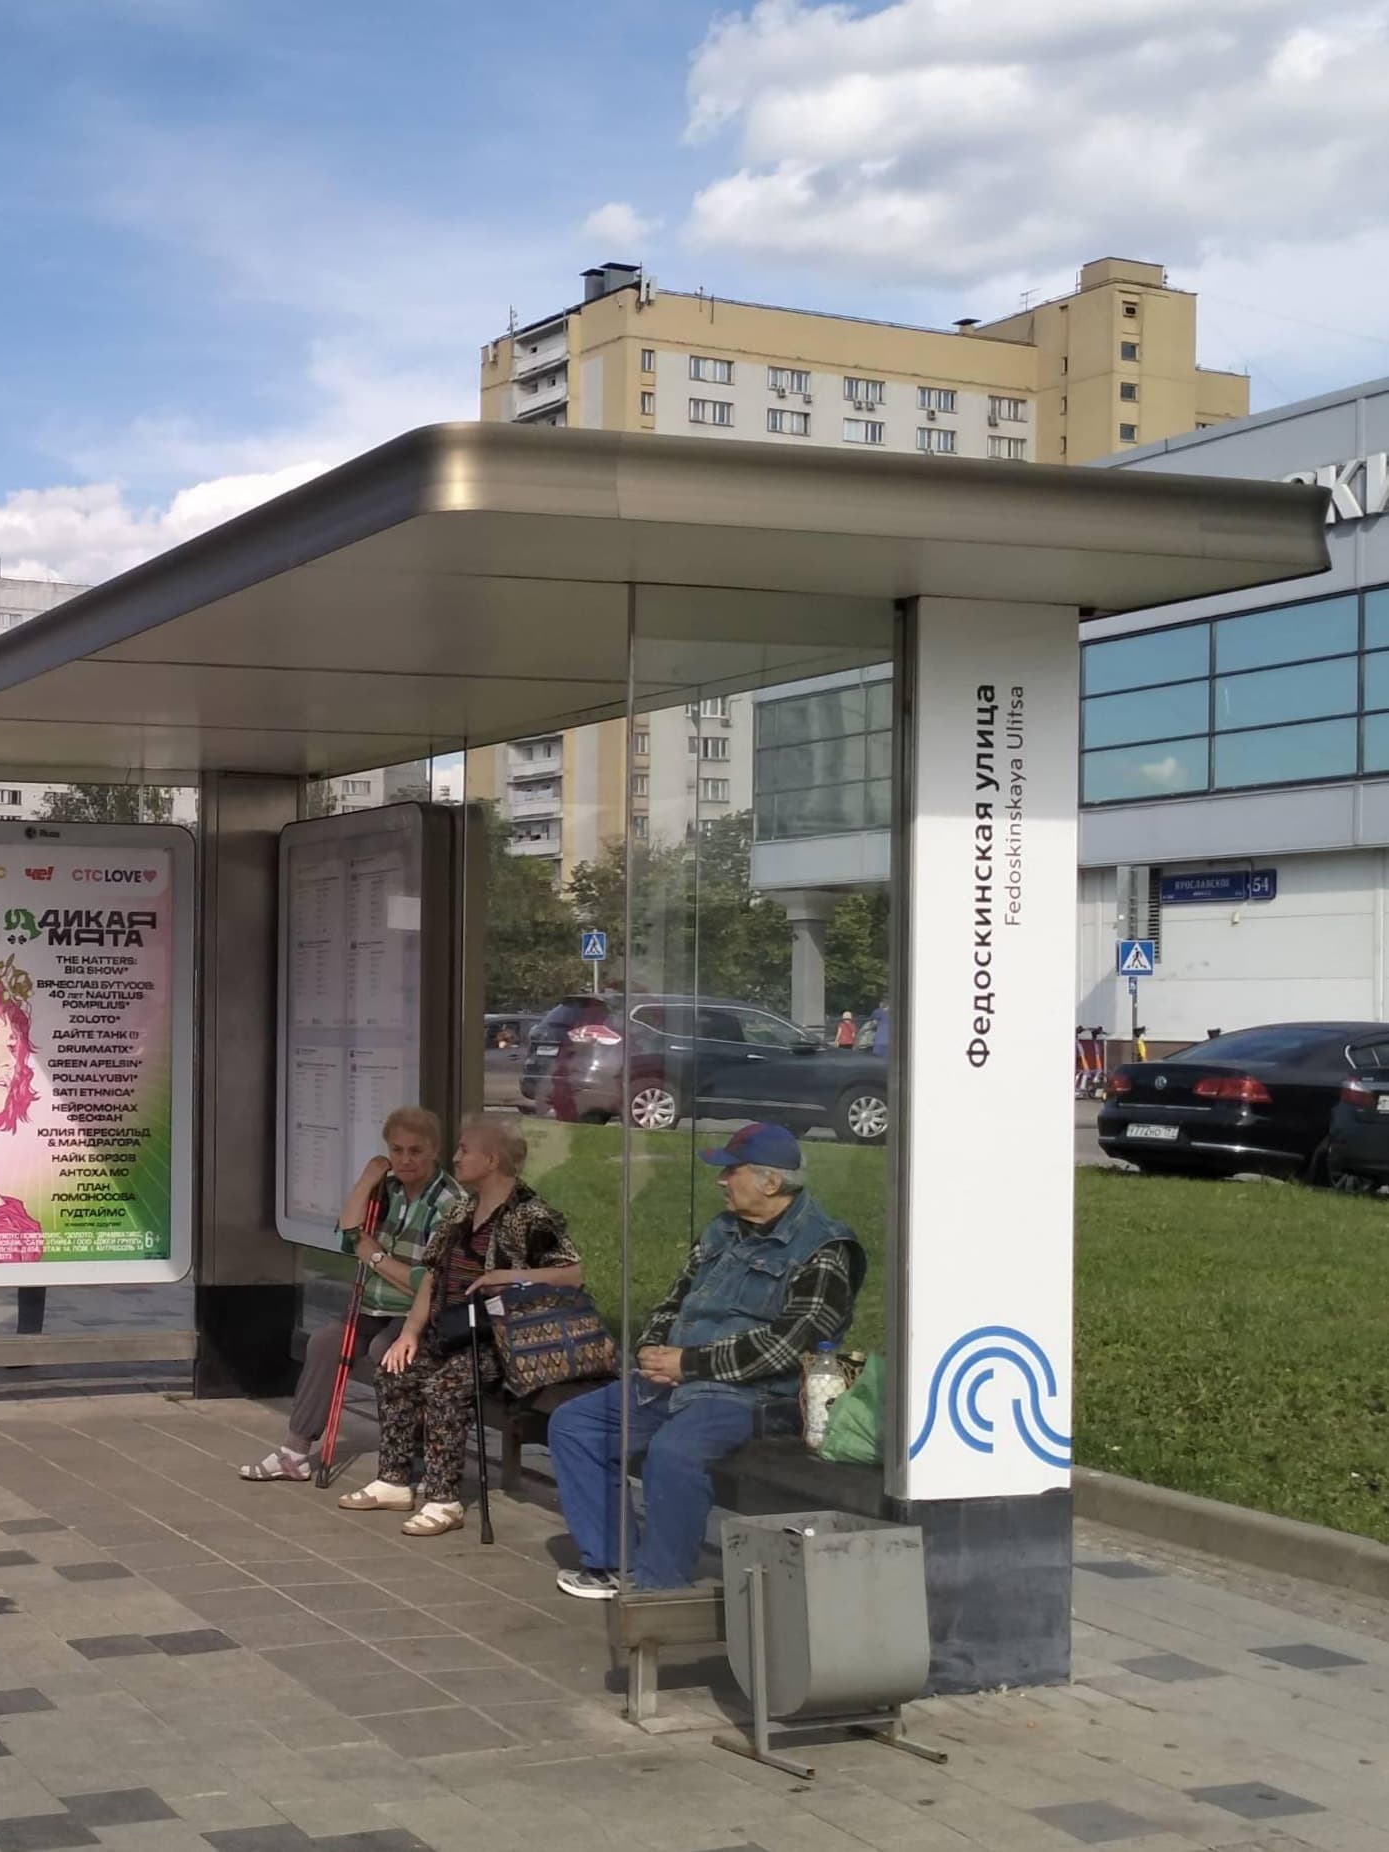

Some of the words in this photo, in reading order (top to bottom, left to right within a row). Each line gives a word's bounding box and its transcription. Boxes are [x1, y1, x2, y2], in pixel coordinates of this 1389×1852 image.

[1006, 684, 1025, 750] Ulitsa
[975, 683, 1000, 792] улица
[1004, 757, 1027, 926] Fedoskinskaya
[1252, 877, 1269, 892] 54
[38, 909, 157, 929] ДИКАЯ
[48, 928, 144, 948] МЯТА
[965, 801, 995, 1069] Федоскинская
[55, 955, 79, 964] THE
[81, 956, 138, 965] HATTERS:
[64, 966, 85, 975] BIG
[36, 980, 99, 989] ВЯЧЕСЛАВ
[49, 990, 65, 999] 40
[86, 991, 144, 1000] NAUTILUS
[52, 1029, 95, 1039] ДАЙТЕ
[96, 1031, 128, 1039] ТАНК
[47, 1059, 88, 1068] GREEN
[52, 1088, 77, 1097] SATI
[52, 1102, 138, 1112] НЕЙРОМОНАХ
[67, 1113, 123, 1122] ФЕОФАН
[37, 1128, 75, 1137] ЮЛИЯ
[77, 1128, 151, 1138] ПЕРЕСИЛЬД
[47, 1139, 56, 1147] &
[58, 1138, 141, 1148] МАНДРАГОРА
[52, 1152, 86, 1162] НАЙК
[88, 1153, 137, 1162] БОРЗОВ
[59, 1168, 107, 1177] АНТОХА
[76, 1182, 110, 1191] ПЛАН
[51, 1193, 136, 1202] ЛОМОНОСОВА
[60, 1207, 126, 1218] ГУДТАЙМС
[145, 1230, 161, 1248] 6+
